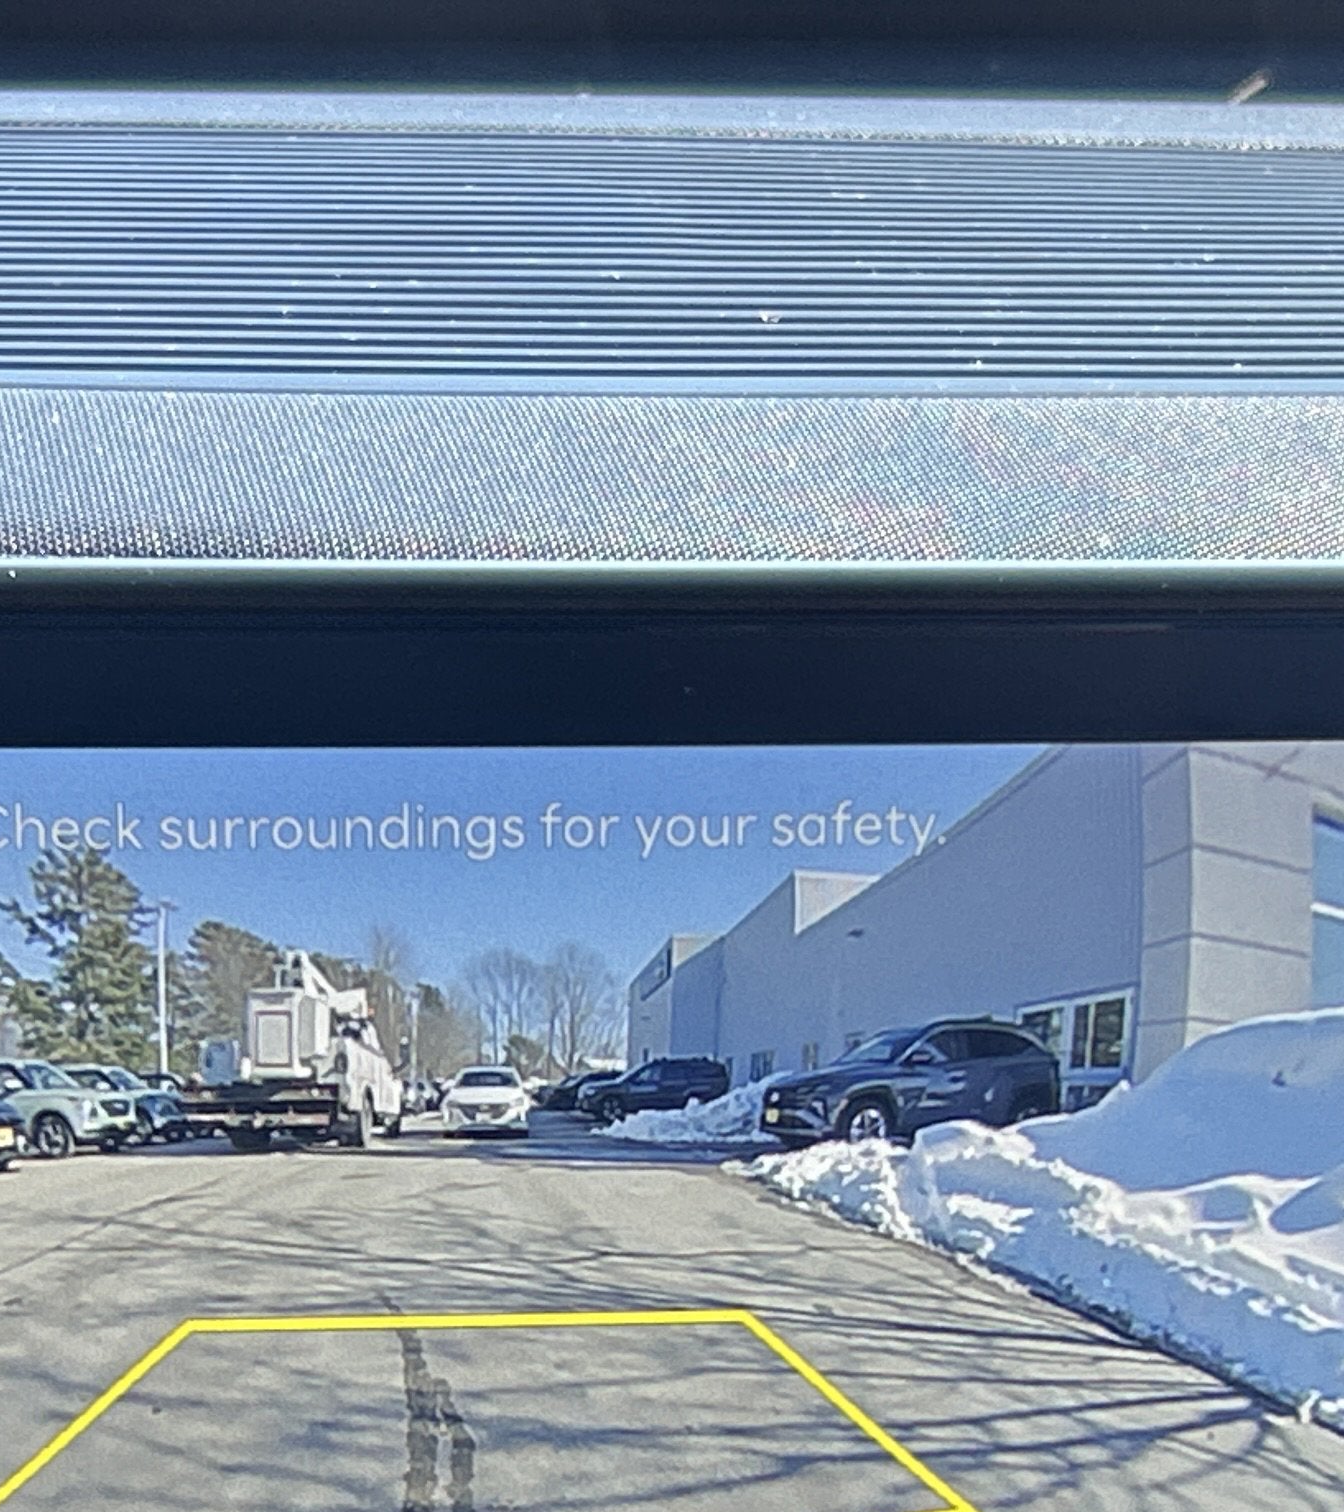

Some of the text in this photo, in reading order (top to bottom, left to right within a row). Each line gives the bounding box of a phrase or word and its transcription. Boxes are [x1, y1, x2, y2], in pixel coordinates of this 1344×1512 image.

[159, 802, 525, 860] surroundings
[540, 801, 620, 848] for
[634, 814, 758, 859] your
[771, 800, 948, 856] safety.
